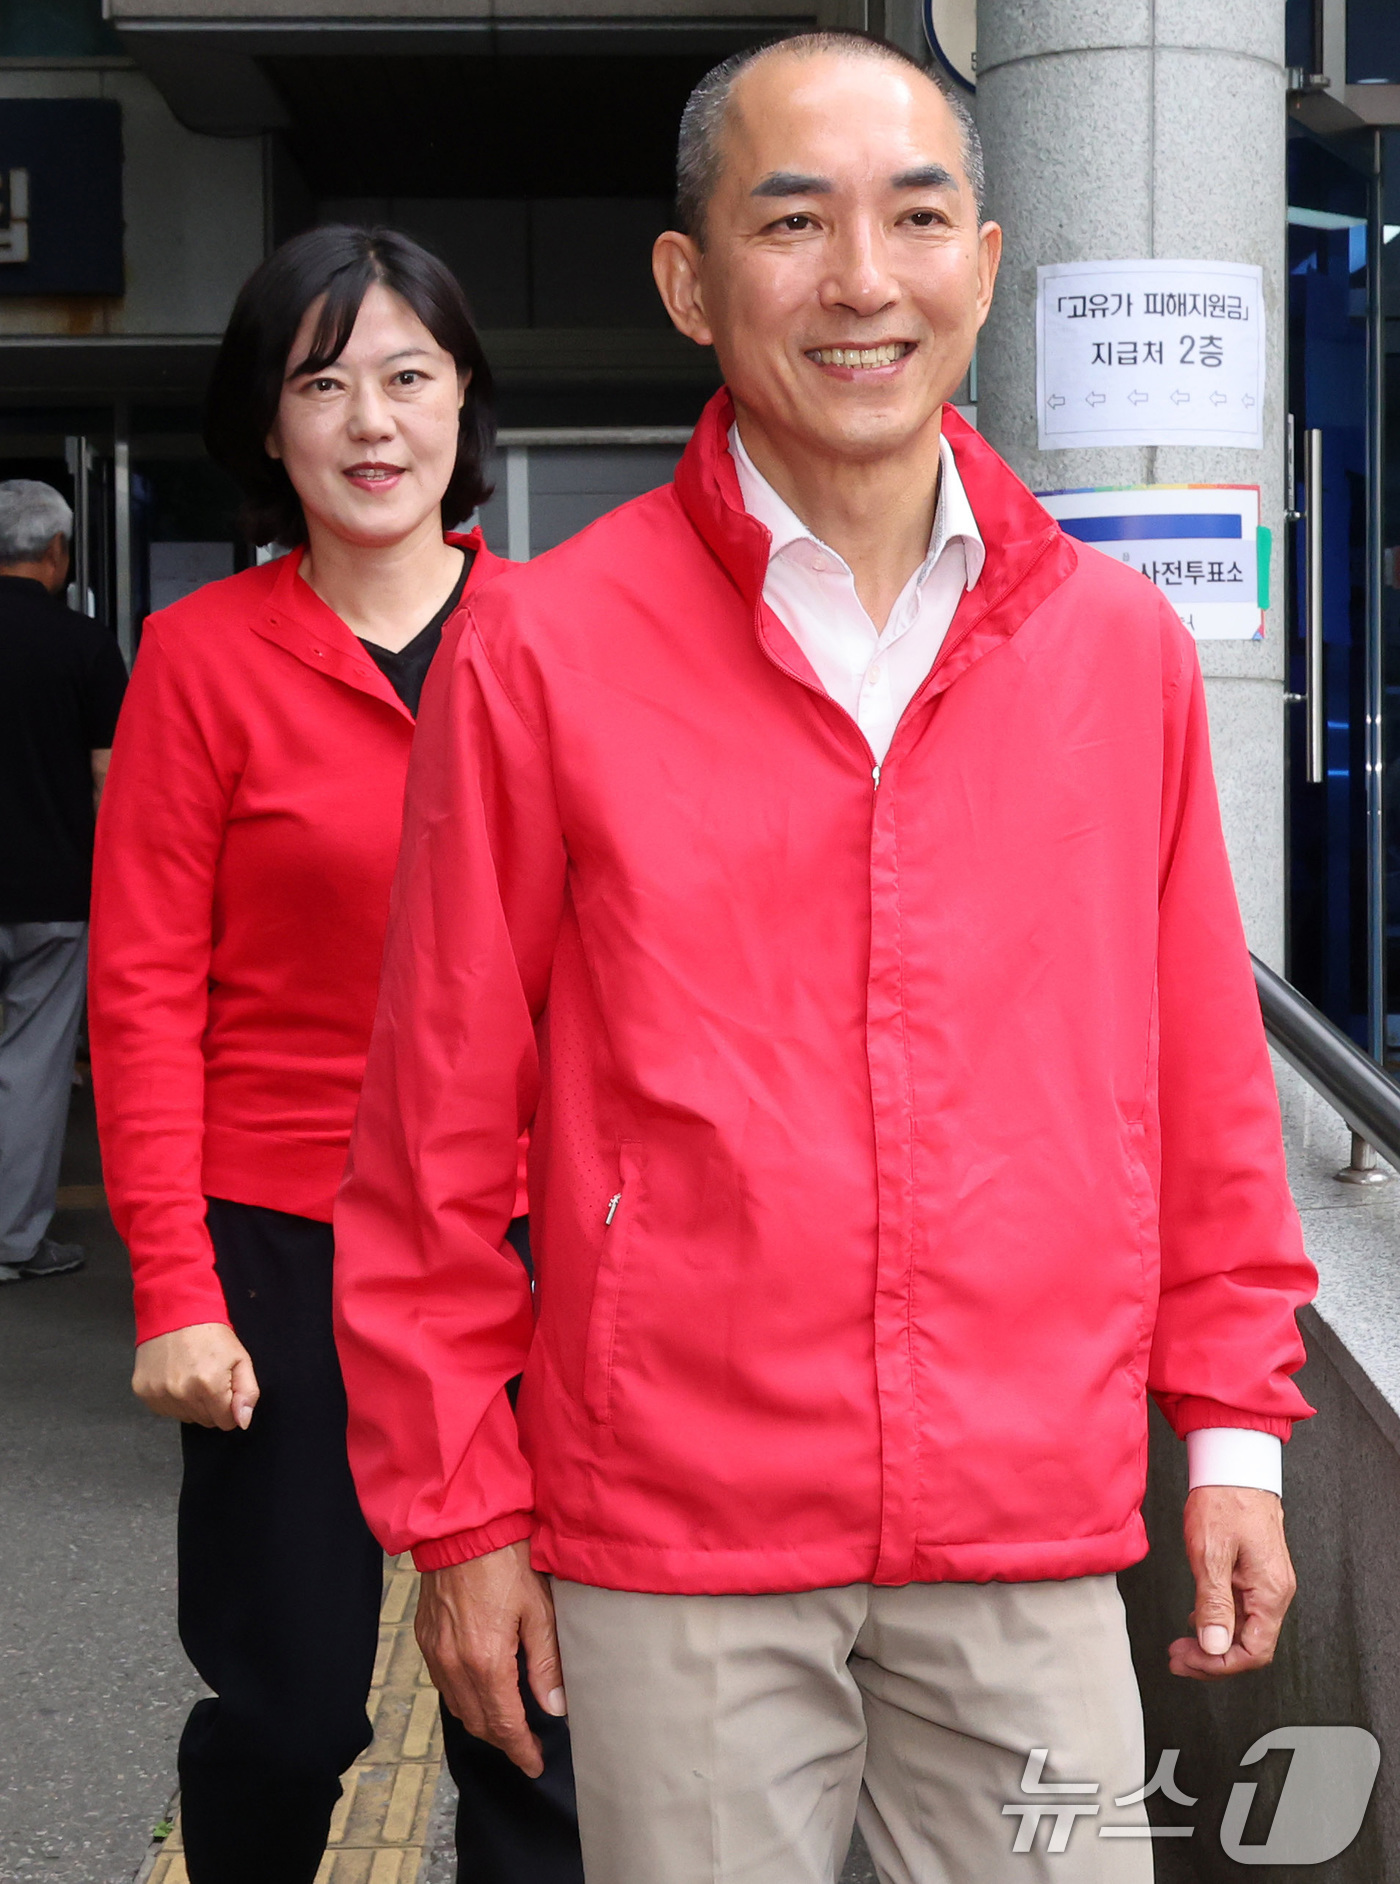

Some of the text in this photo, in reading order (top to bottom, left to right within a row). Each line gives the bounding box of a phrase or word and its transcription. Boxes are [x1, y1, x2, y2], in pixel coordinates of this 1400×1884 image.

[1057, 292, 1249, 321] 「고유가 피해지원금」
[1091, 335, 1224, 368] 지급처 2층
[1141, 560, 1244, 586] 사전투표소
